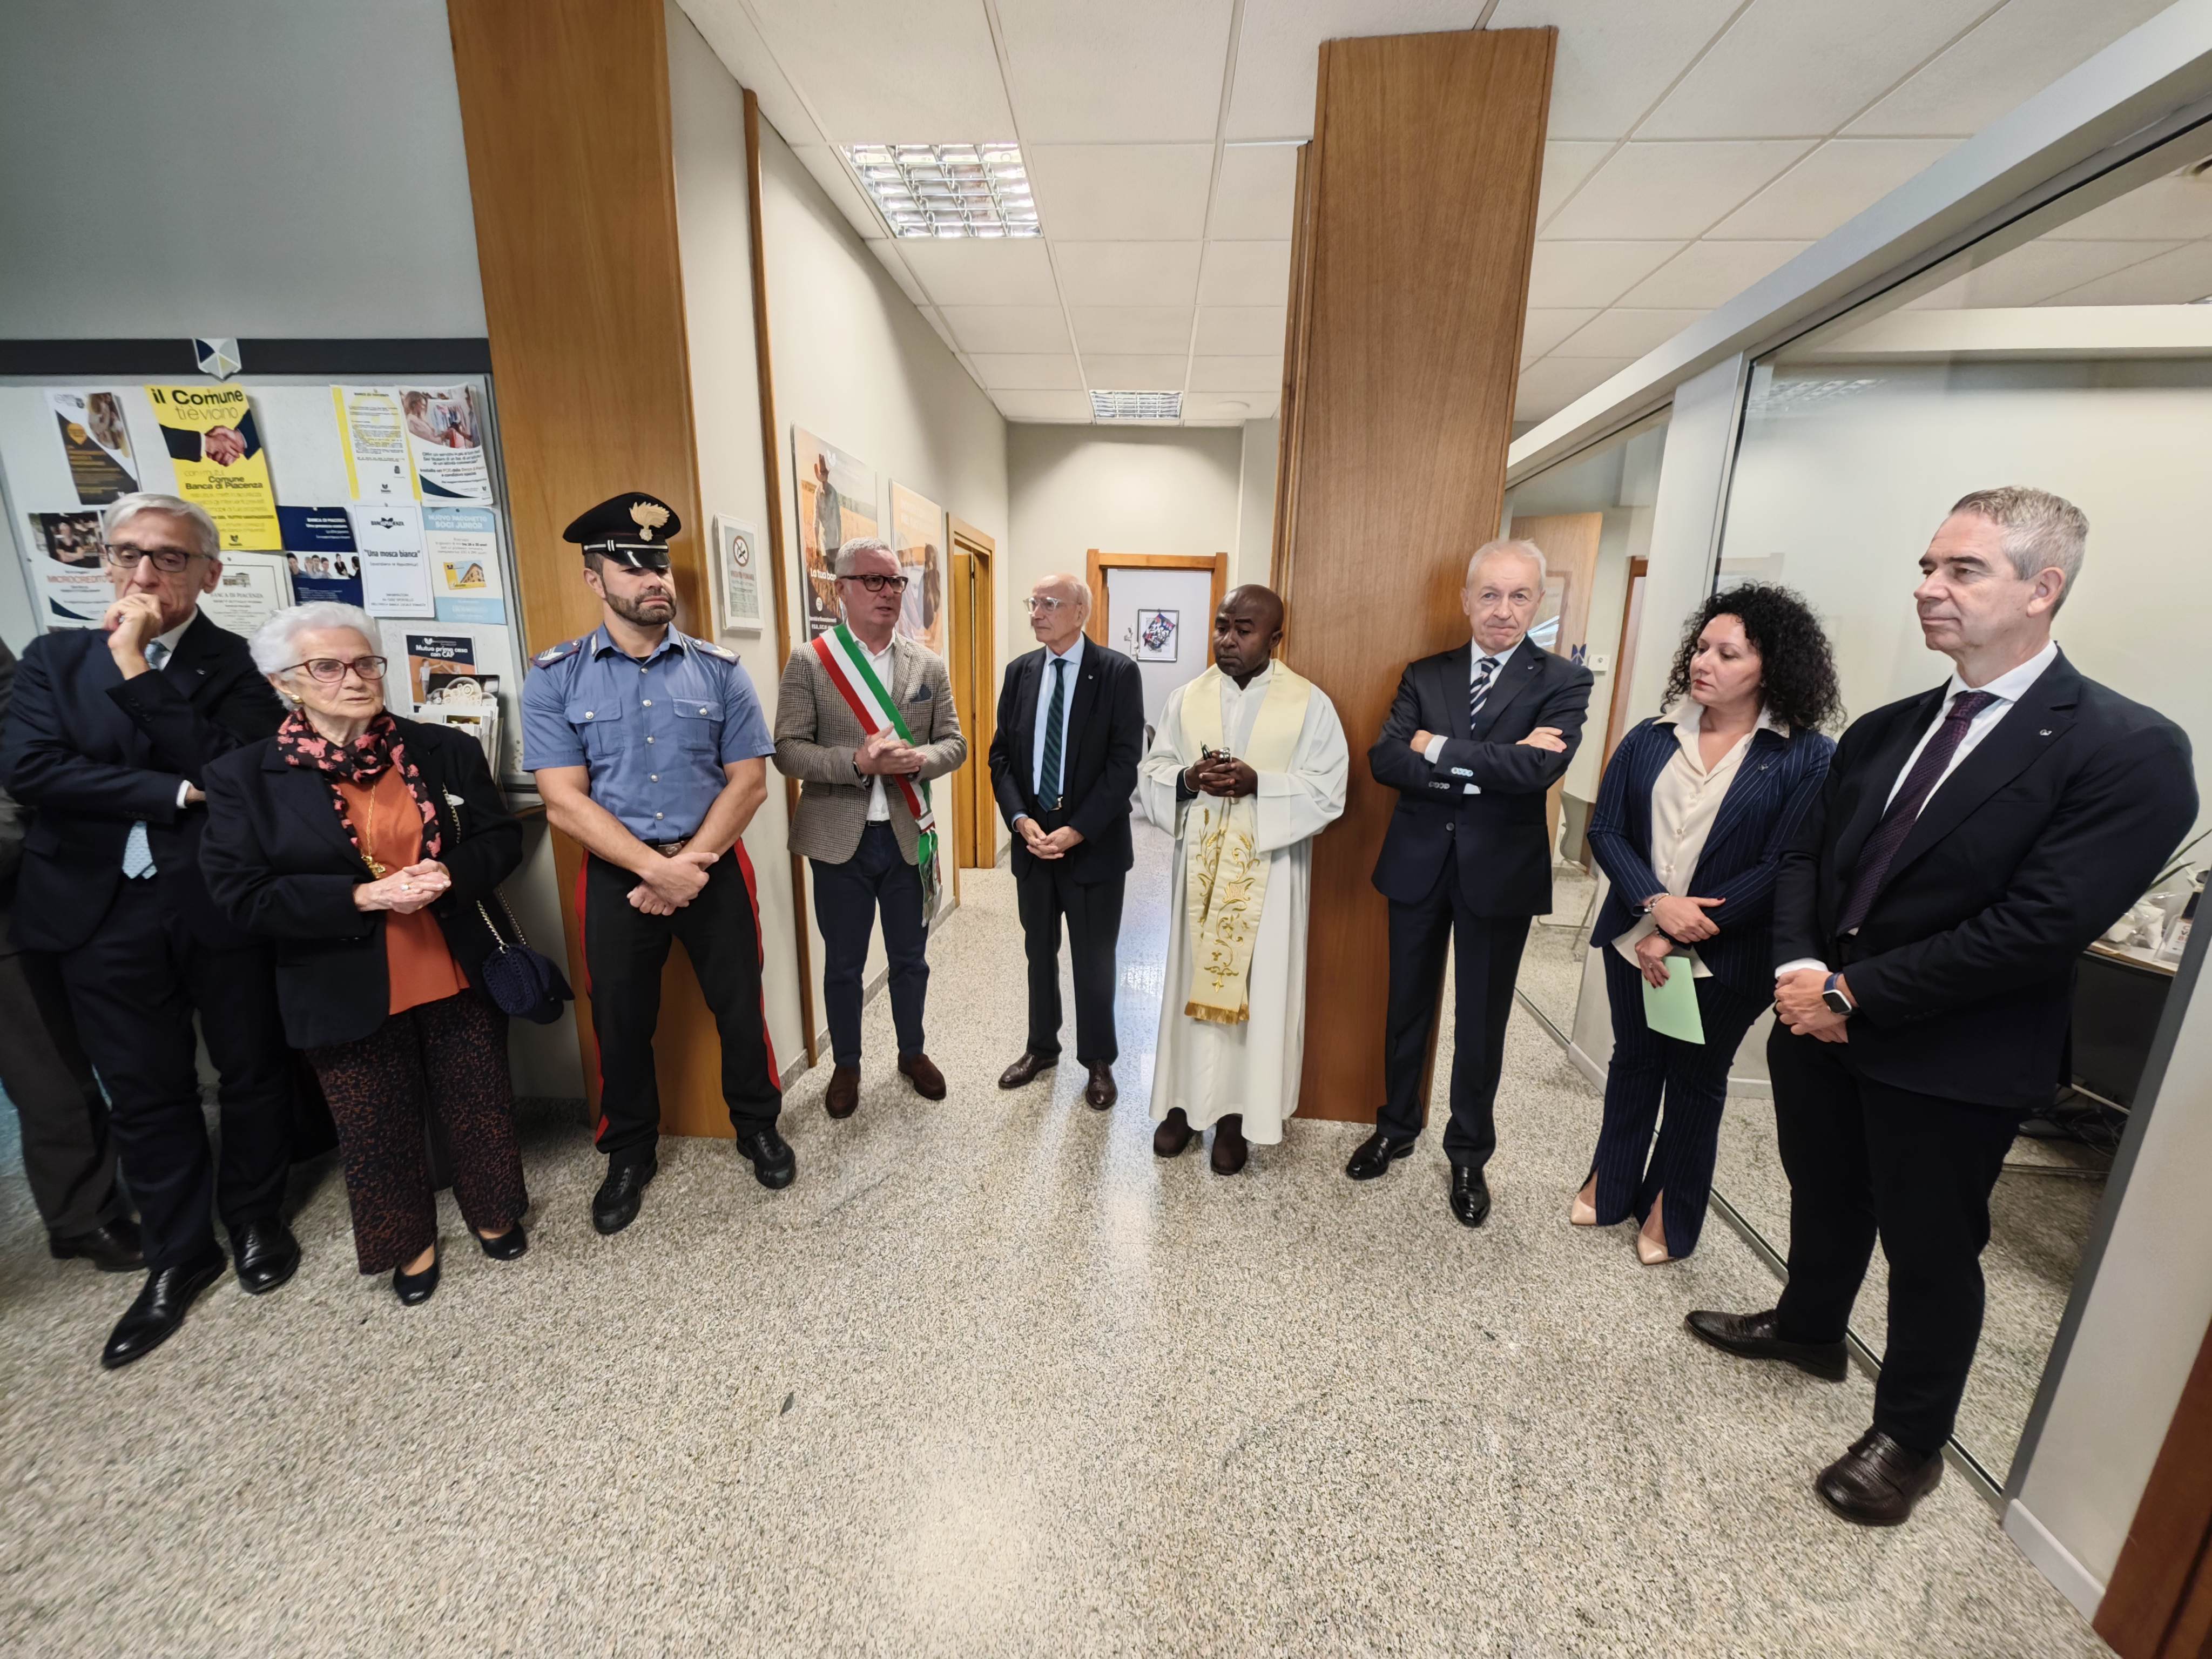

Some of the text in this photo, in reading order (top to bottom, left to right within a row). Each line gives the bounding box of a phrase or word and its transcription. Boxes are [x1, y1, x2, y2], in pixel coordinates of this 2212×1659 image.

[151, 388, 244, 405] il Comune
[810, 567, 817, 578] La
[817, 569, 826, 579] tua
